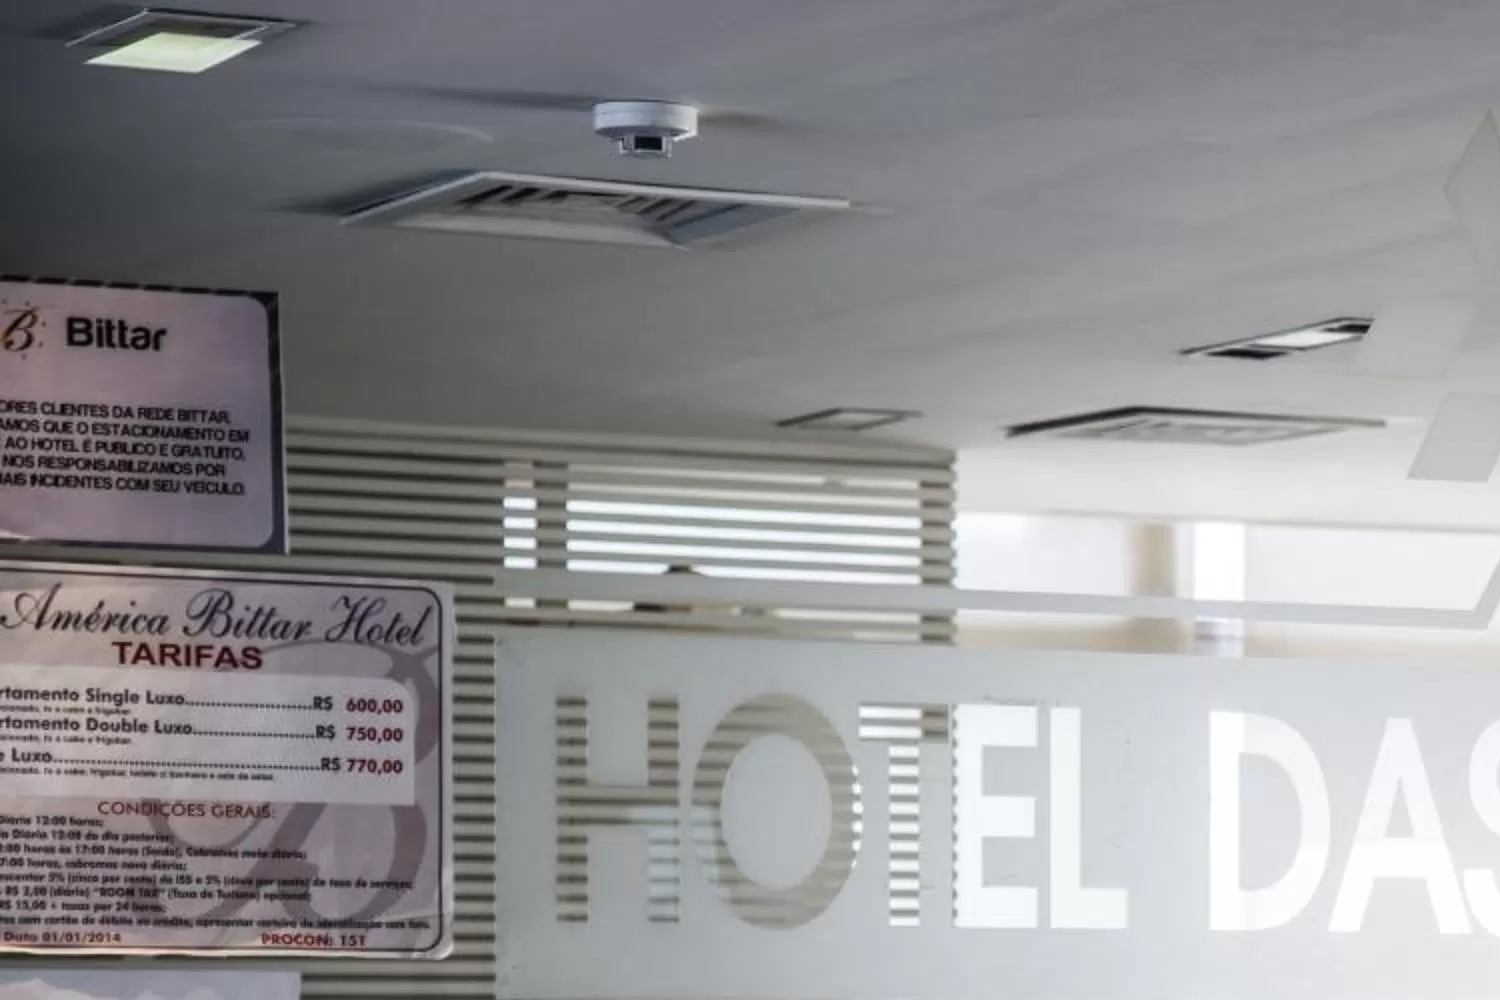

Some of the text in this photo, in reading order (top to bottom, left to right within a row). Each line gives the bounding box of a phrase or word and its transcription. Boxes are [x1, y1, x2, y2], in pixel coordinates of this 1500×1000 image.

[66, 317, 167, 351] Bittar
[41, 402, 108, 417] CLIENTES
[112, 406, 134, 418] DA
[138, 407, 176, 420] REDE
[43, 420, 74, 434] QUE
[77, 421, 88, 435] O
[92, 422, 225, 442] ESTACIONAMENTO
[228, 429, 249, 443] EM
[5, 436, 28, 450] AO
[31, 437, 79, 452] HOTEL
[159, 443, 169, 457] E
[3, 454, 226, 478] NOS RESPONSABILIZAMOS POR
[0, 472, 27, 487] AIS
[30, 473, 113, 490] INCIDENTES
[115, 477, 150, 491] COM
[152, 479, 180, 493] SEU
[0, 582, 433, 646] América Bittar Hotel
[111, 641, 263, 669] TARIFAS
[85, 687, 140, 706] Single
[313, 695, 333, 711] R$
[346, 697, 403, 715] 600,00
[86, 717, 148, 734] Double
[316, 724, 336, 740] R$
[346, 727, 403, 744] 750,00
[321, 757, 341, 771] R$
[346, 758, 403, 776] 770,00
[554, 693, 1130, 931] HOTEL
